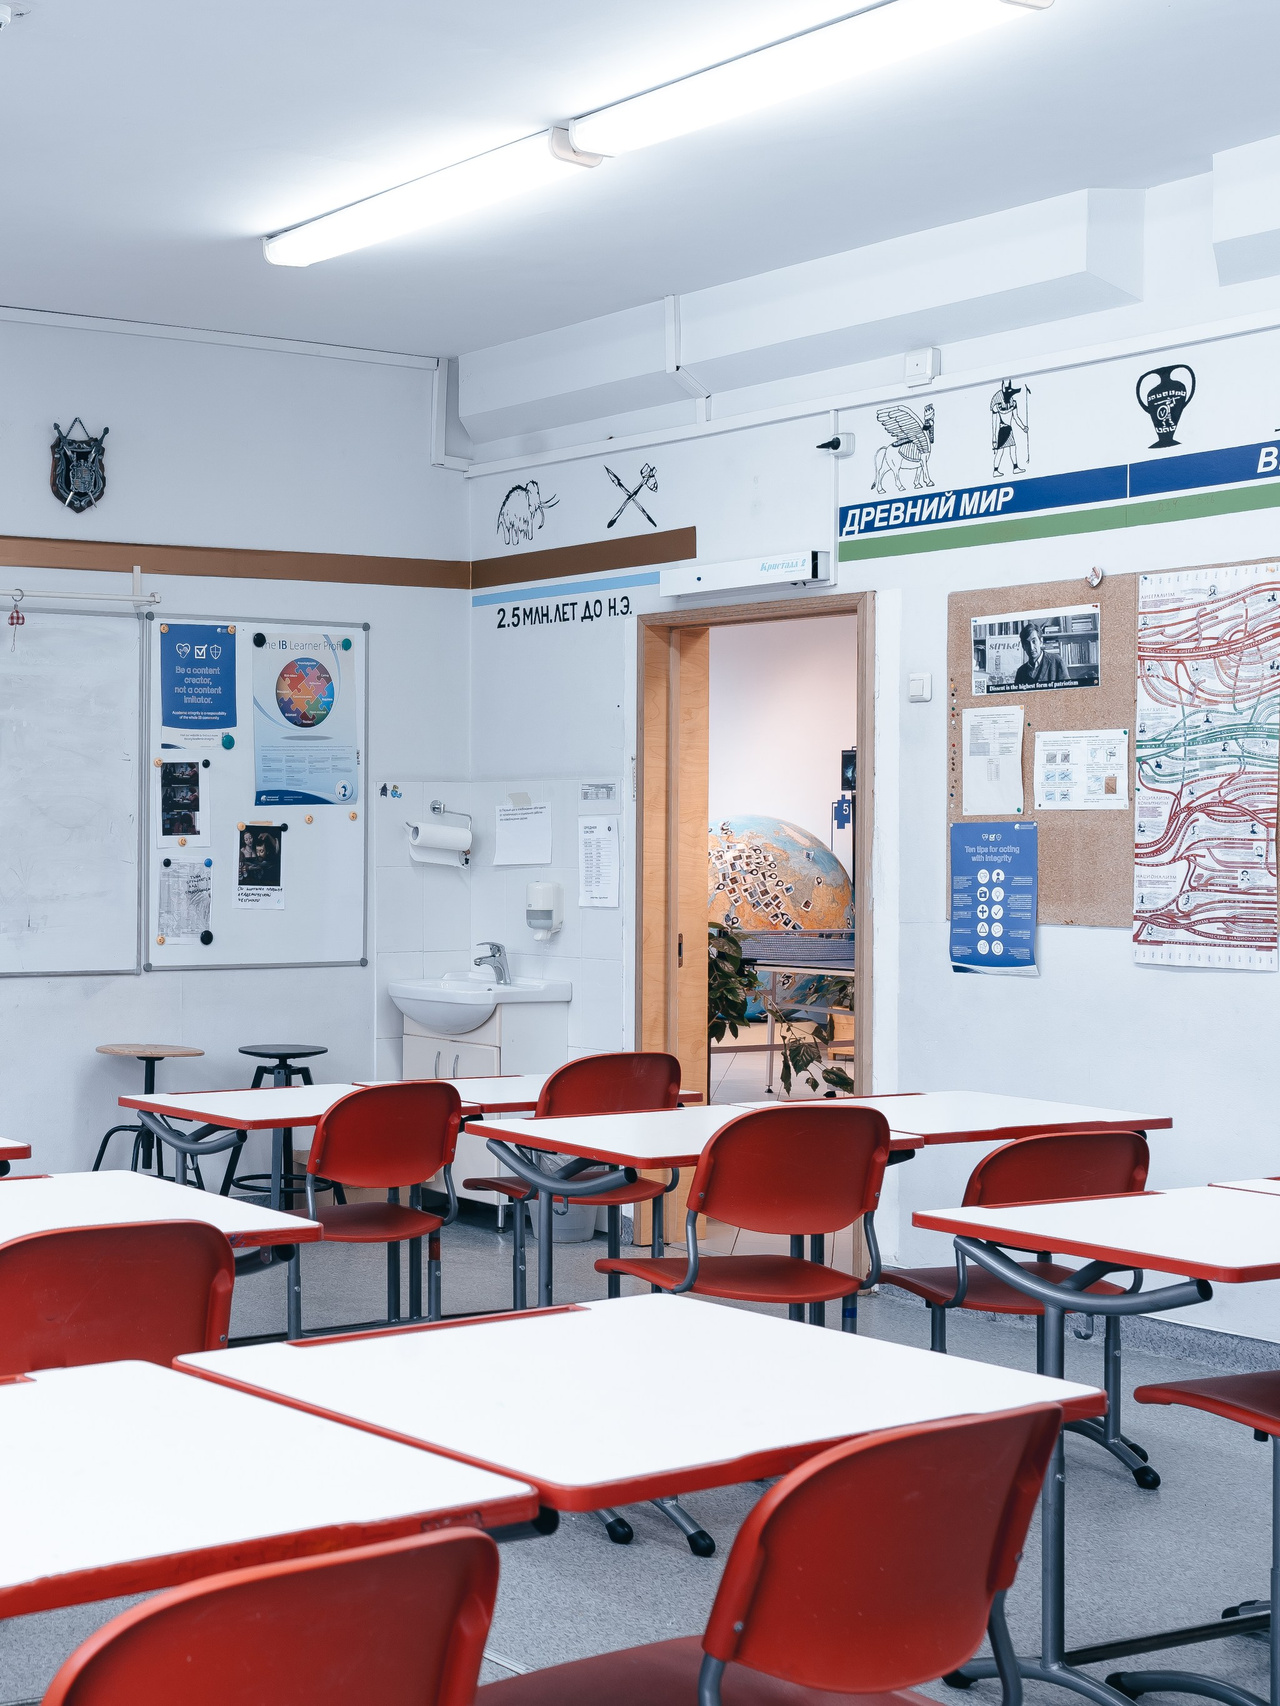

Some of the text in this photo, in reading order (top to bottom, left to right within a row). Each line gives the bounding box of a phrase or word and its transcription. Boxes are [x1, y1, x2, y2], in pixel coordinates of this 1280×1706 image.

[841, 487, 1014, 537] ДРЕВНИЙ МИР
[497, 606, 520, 629] 2.5
[581, 599, 603, 623] ДО
[608, 595, 633, 617] Н.Э.
[262, 641, 276, 650] he
[278, 640, 287, 649] IB
[290, 641, 321, 650] Learner
[175, 666, 185, 674] Be
[192, 666, 220, 675] content
[184, 677, 213, 685] creator,
[1019, 682, 1036, 691] highest
[1053, 680, 1079, 689] patriotism
[175, 686, 186, 694] not
[193, 686, 222, 694] content
[184, 695, 213, 704] imitator.
[842, 803, 850, 815] 5
[965, 845, 1020, 854] Ten tips for acting
[971, 854, 1012, 863] with integrity
